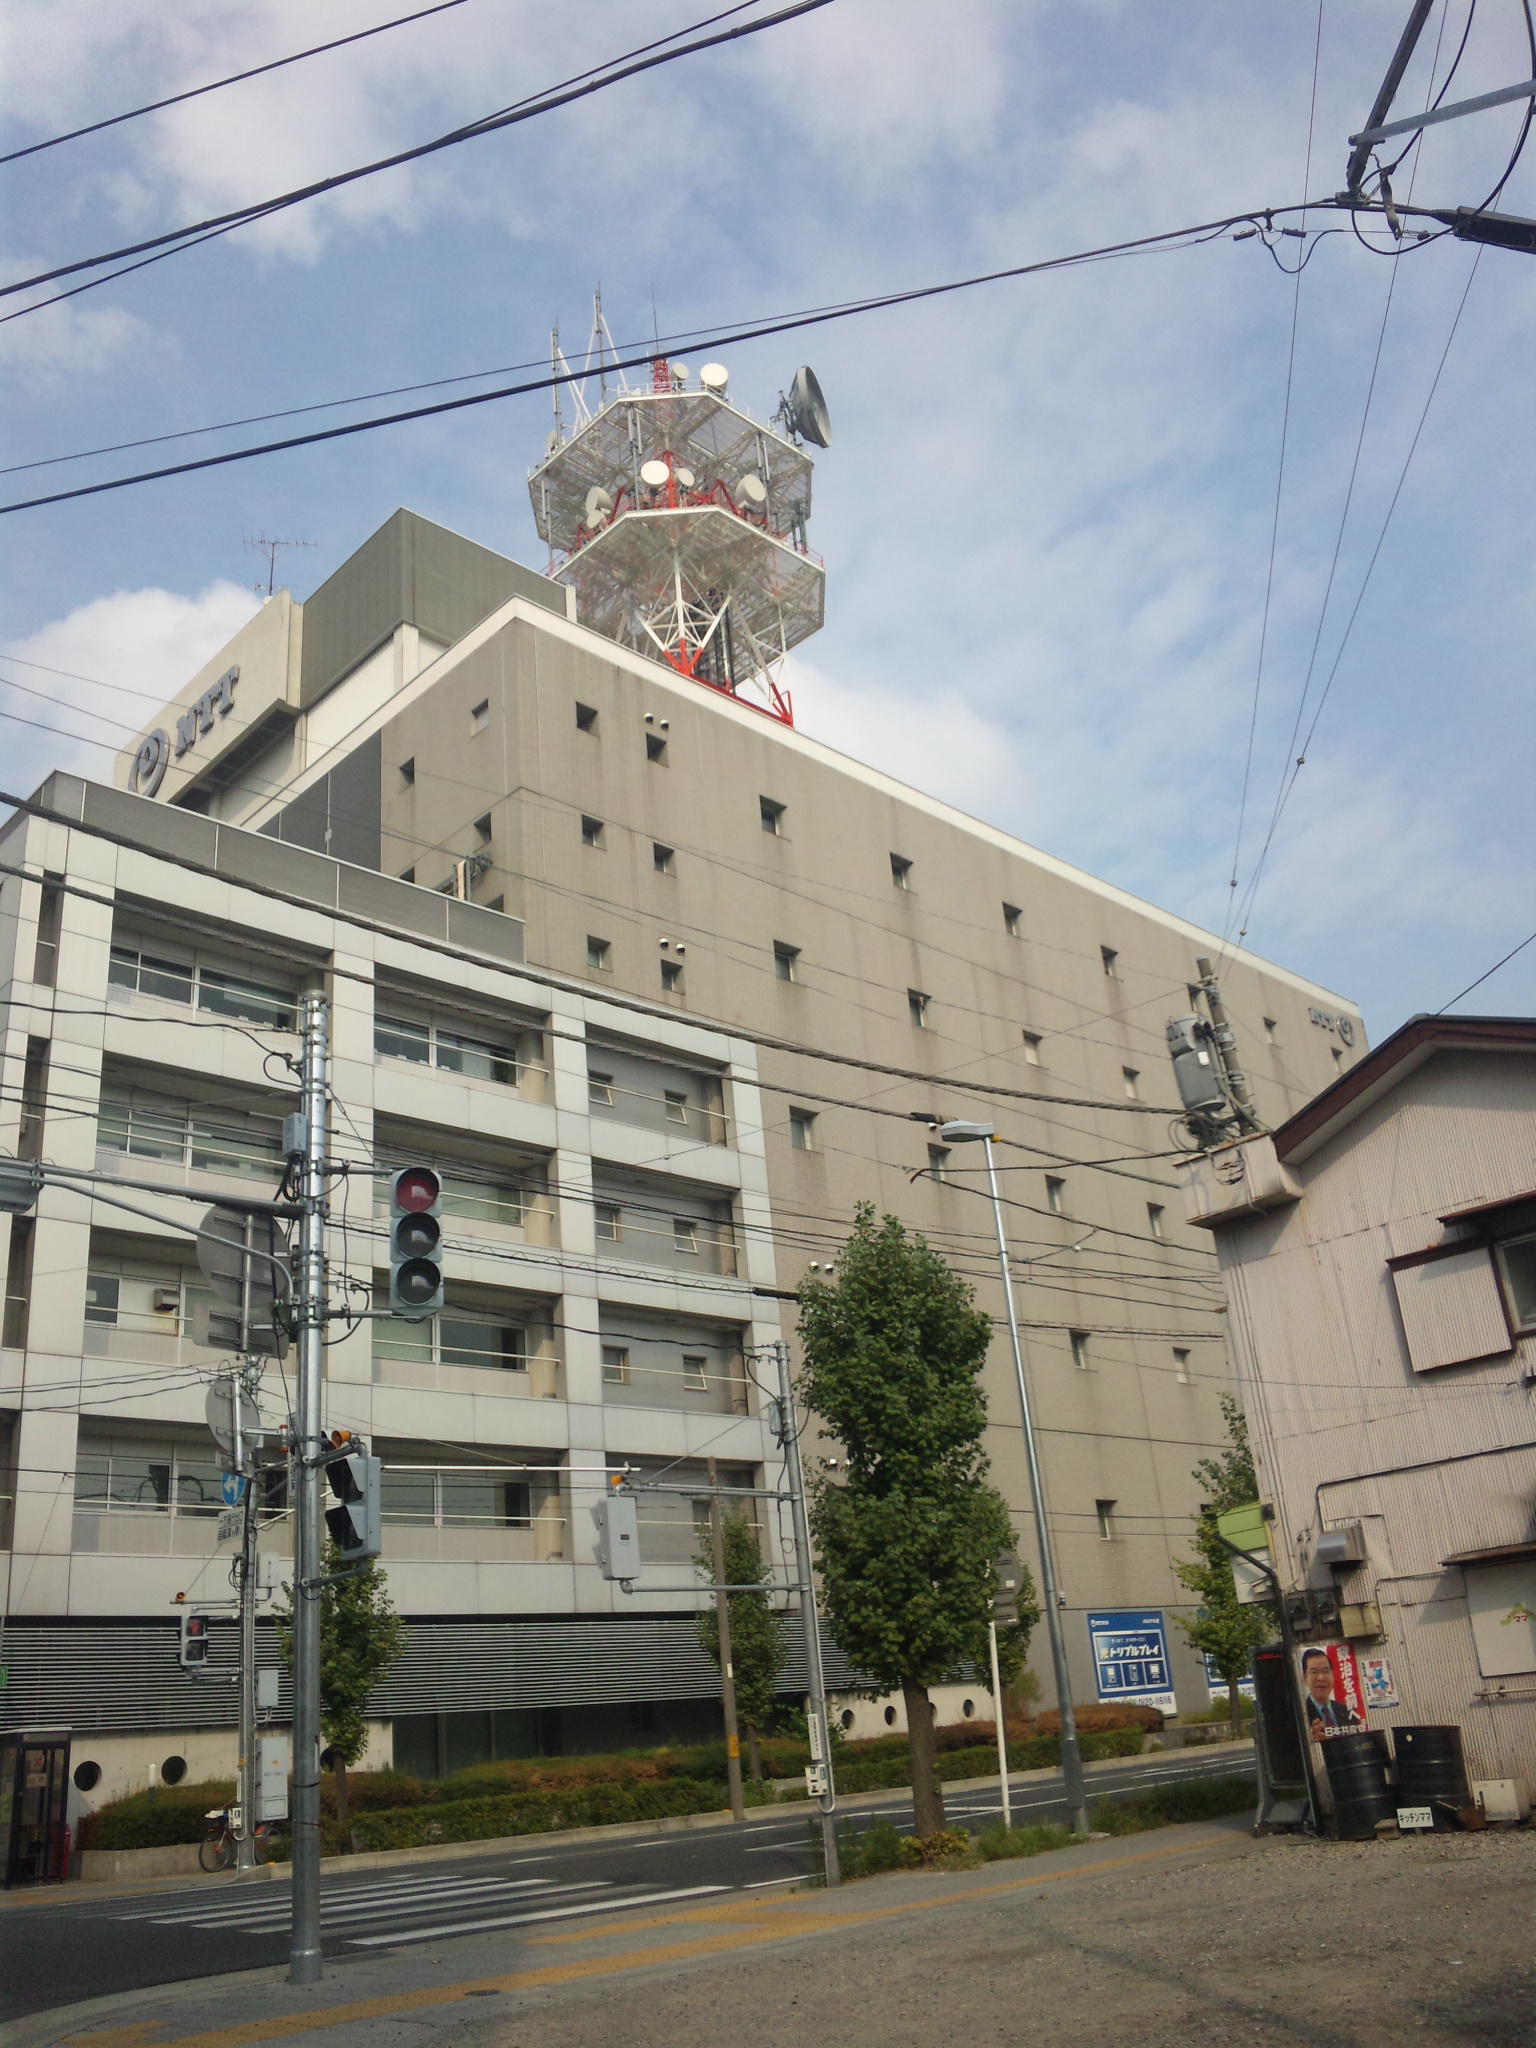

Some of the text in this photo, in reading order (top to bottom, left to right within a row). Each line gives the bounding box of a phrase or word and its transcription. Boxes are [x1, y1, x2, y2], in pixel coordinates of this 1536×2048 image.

[175, 664, 239, 757] NTT
[1100, 1644, 1160, 1659] 光トリプルプレイ
[1336, 1645, 1361, 1720] 政治を前へ
[1398, 1812, 1431, 1823] キッチンママ
